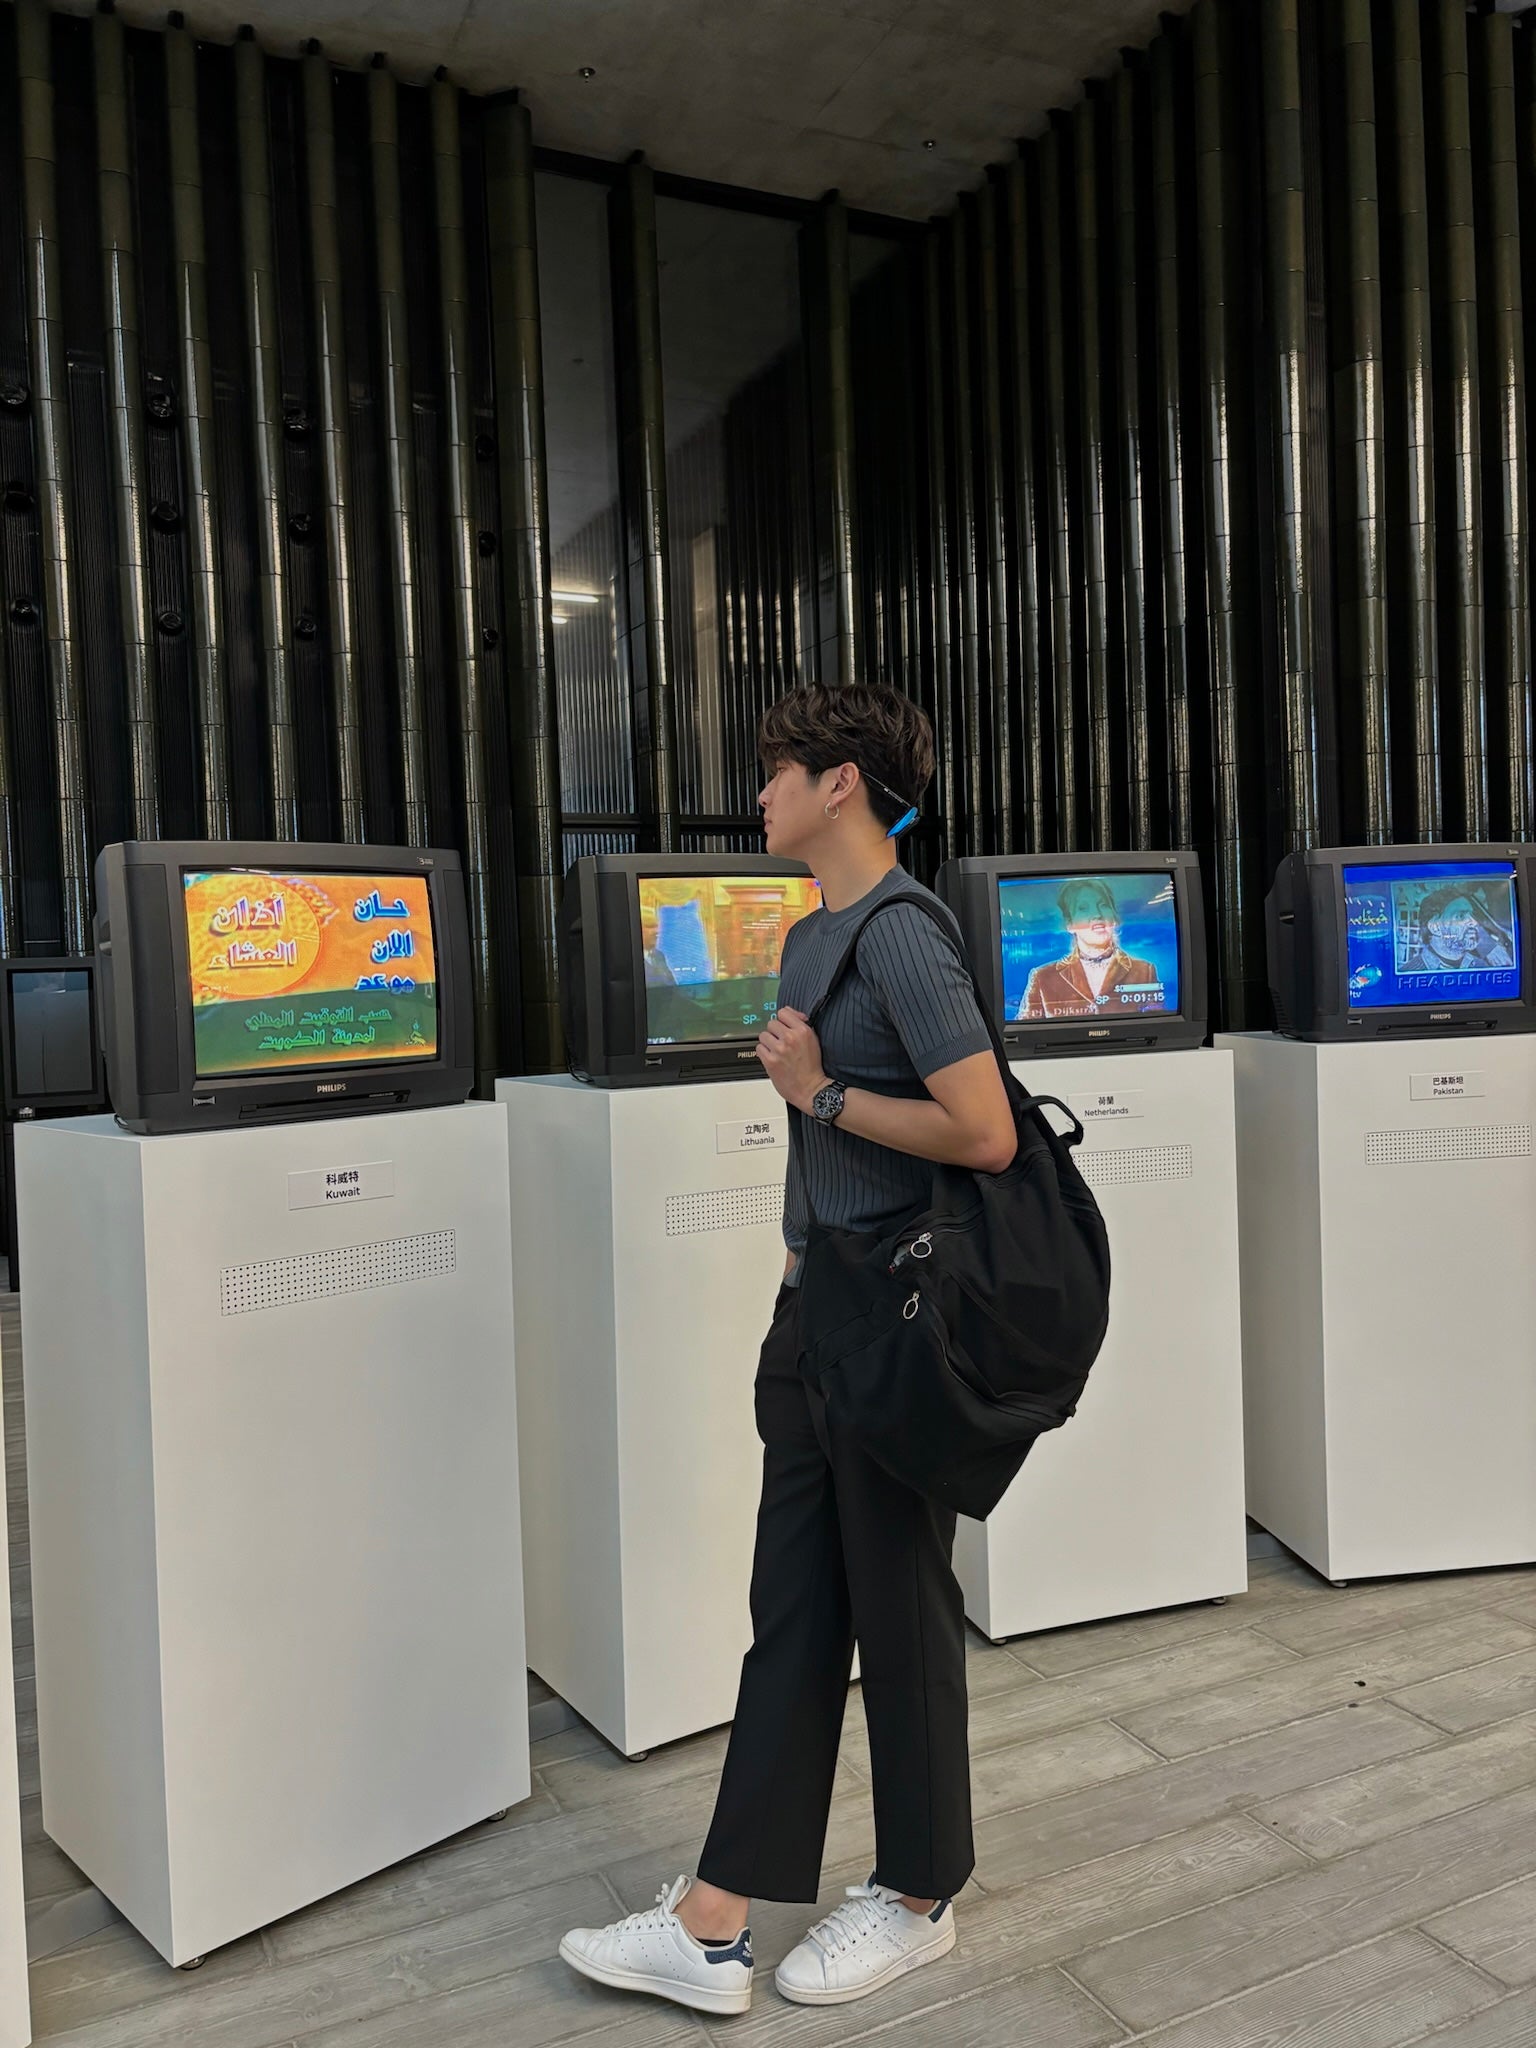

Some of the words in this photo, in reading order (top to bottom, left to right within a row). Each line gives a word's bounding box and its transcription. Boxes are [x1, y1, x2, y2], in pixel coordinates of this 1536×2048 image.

[354, 889, 411, 922] حان
[354, 973, 415, 995] موعد
[1095, 995, 1110, 1004] SP
[1121, 992, 1165, 1004] 0:01:15
[742, 1013, 757, 1025] SP
[258, 1028, 326, 1051] الكويت
[737, 1051, 758, 1059] PHILIP
[1432, 1076, 1464, 1086] 巴基斯坦
[316, 1083, 347, 1093] PHILIPS
[1433, 1087, 1464, 1095] Pakistan
[1084, 1107, 1129, 1117] Netherlands
[745, 1123, 770, 1135] 立陶宛
[740, 1136, 775, 1147] Lithuania
[325, 1170, 359, 1186] 科威特
[326, 1187, 361, 1199] Kuwait
